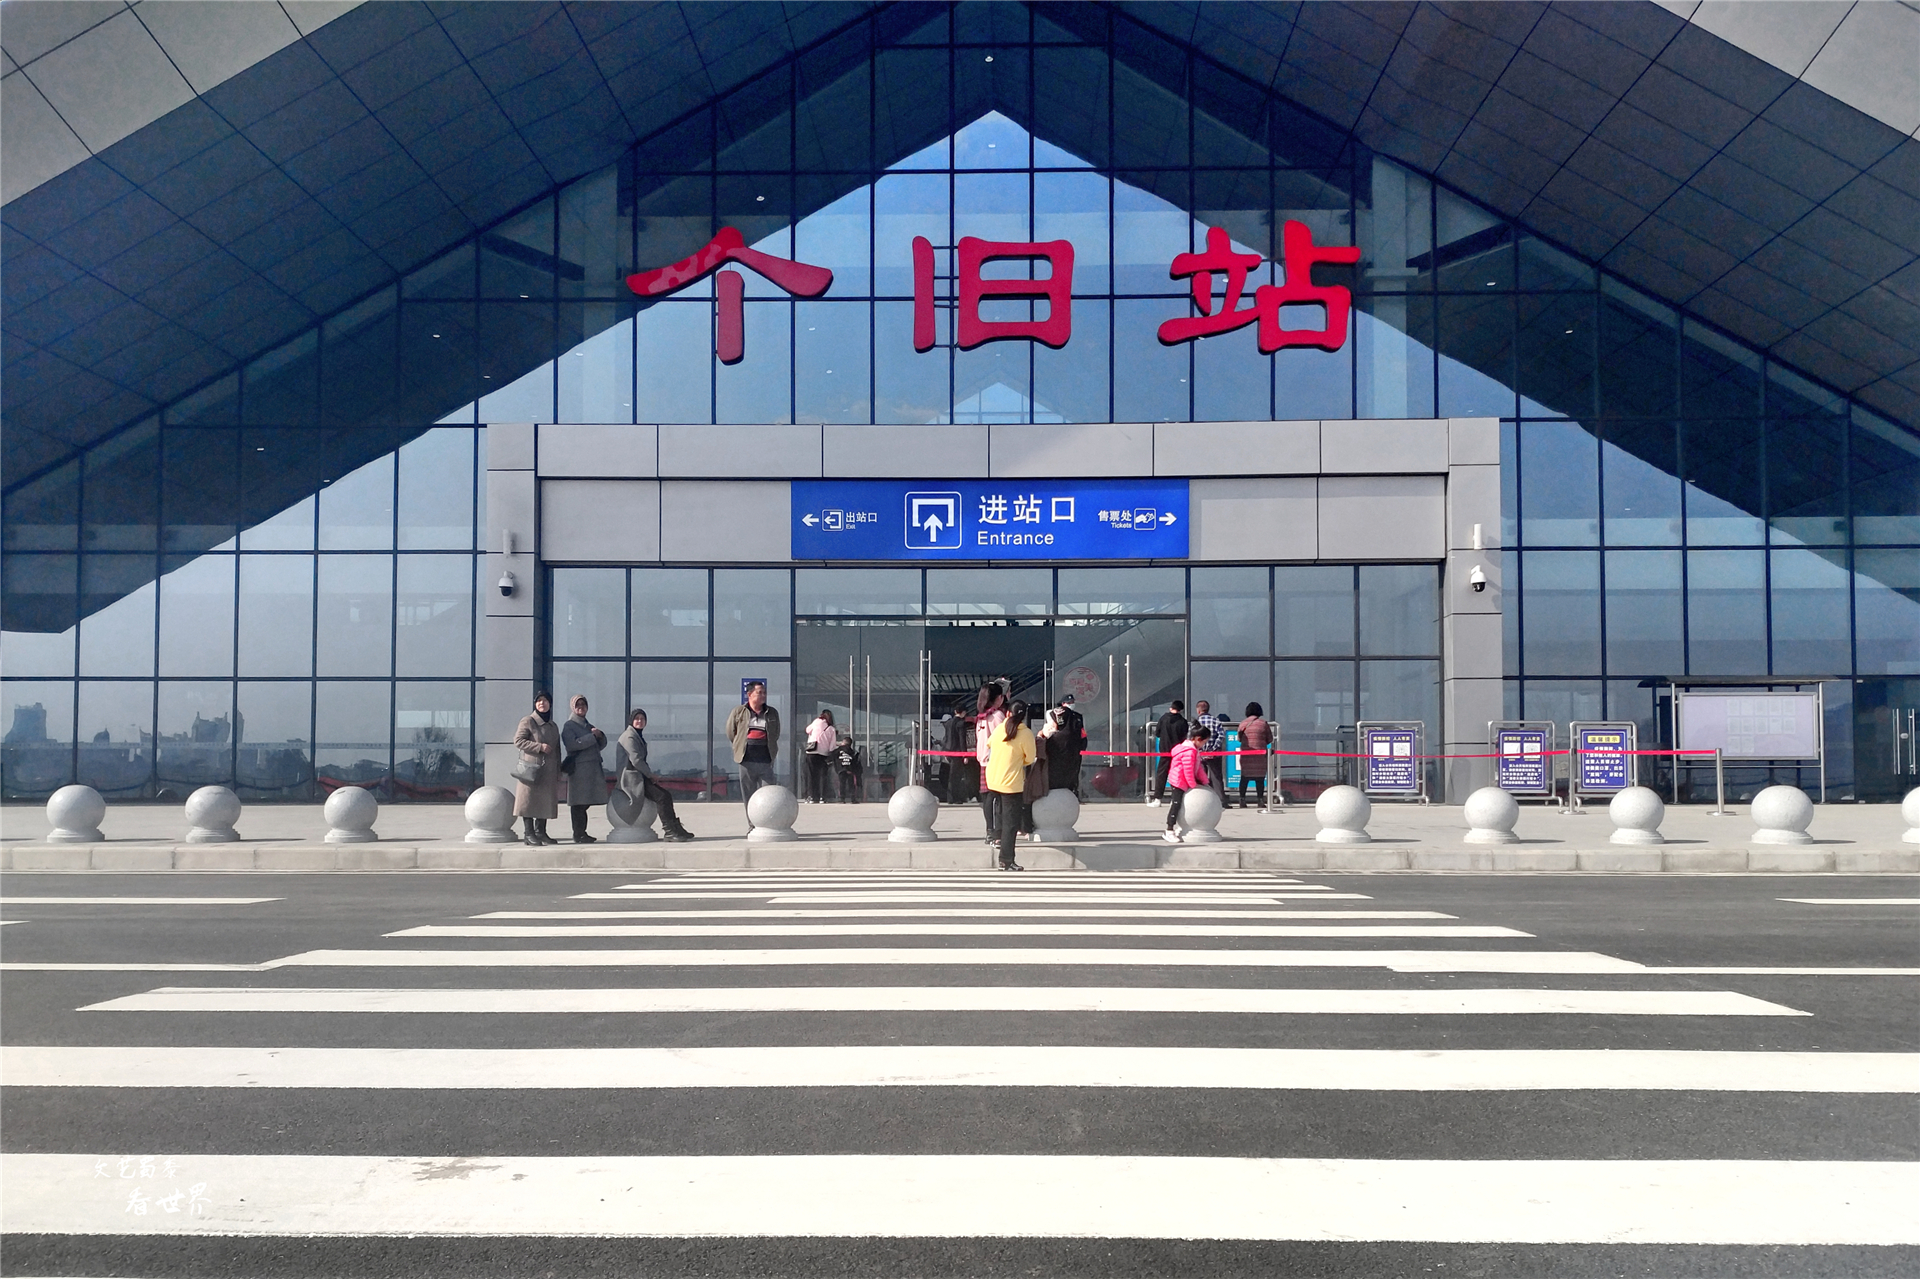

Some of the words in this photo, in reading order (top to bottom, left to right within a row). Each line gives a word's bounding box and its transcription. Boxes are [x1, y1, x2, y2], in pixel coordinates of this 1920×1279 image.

[625, 219, 1361, 365] 个旧站
[978, 494, 1075, 524] 进站口
[845, 511, 878, 523] 出站口
[1097, 510, 1132, 523] 售票处
[977, 531, 1054, 545] Entrance
